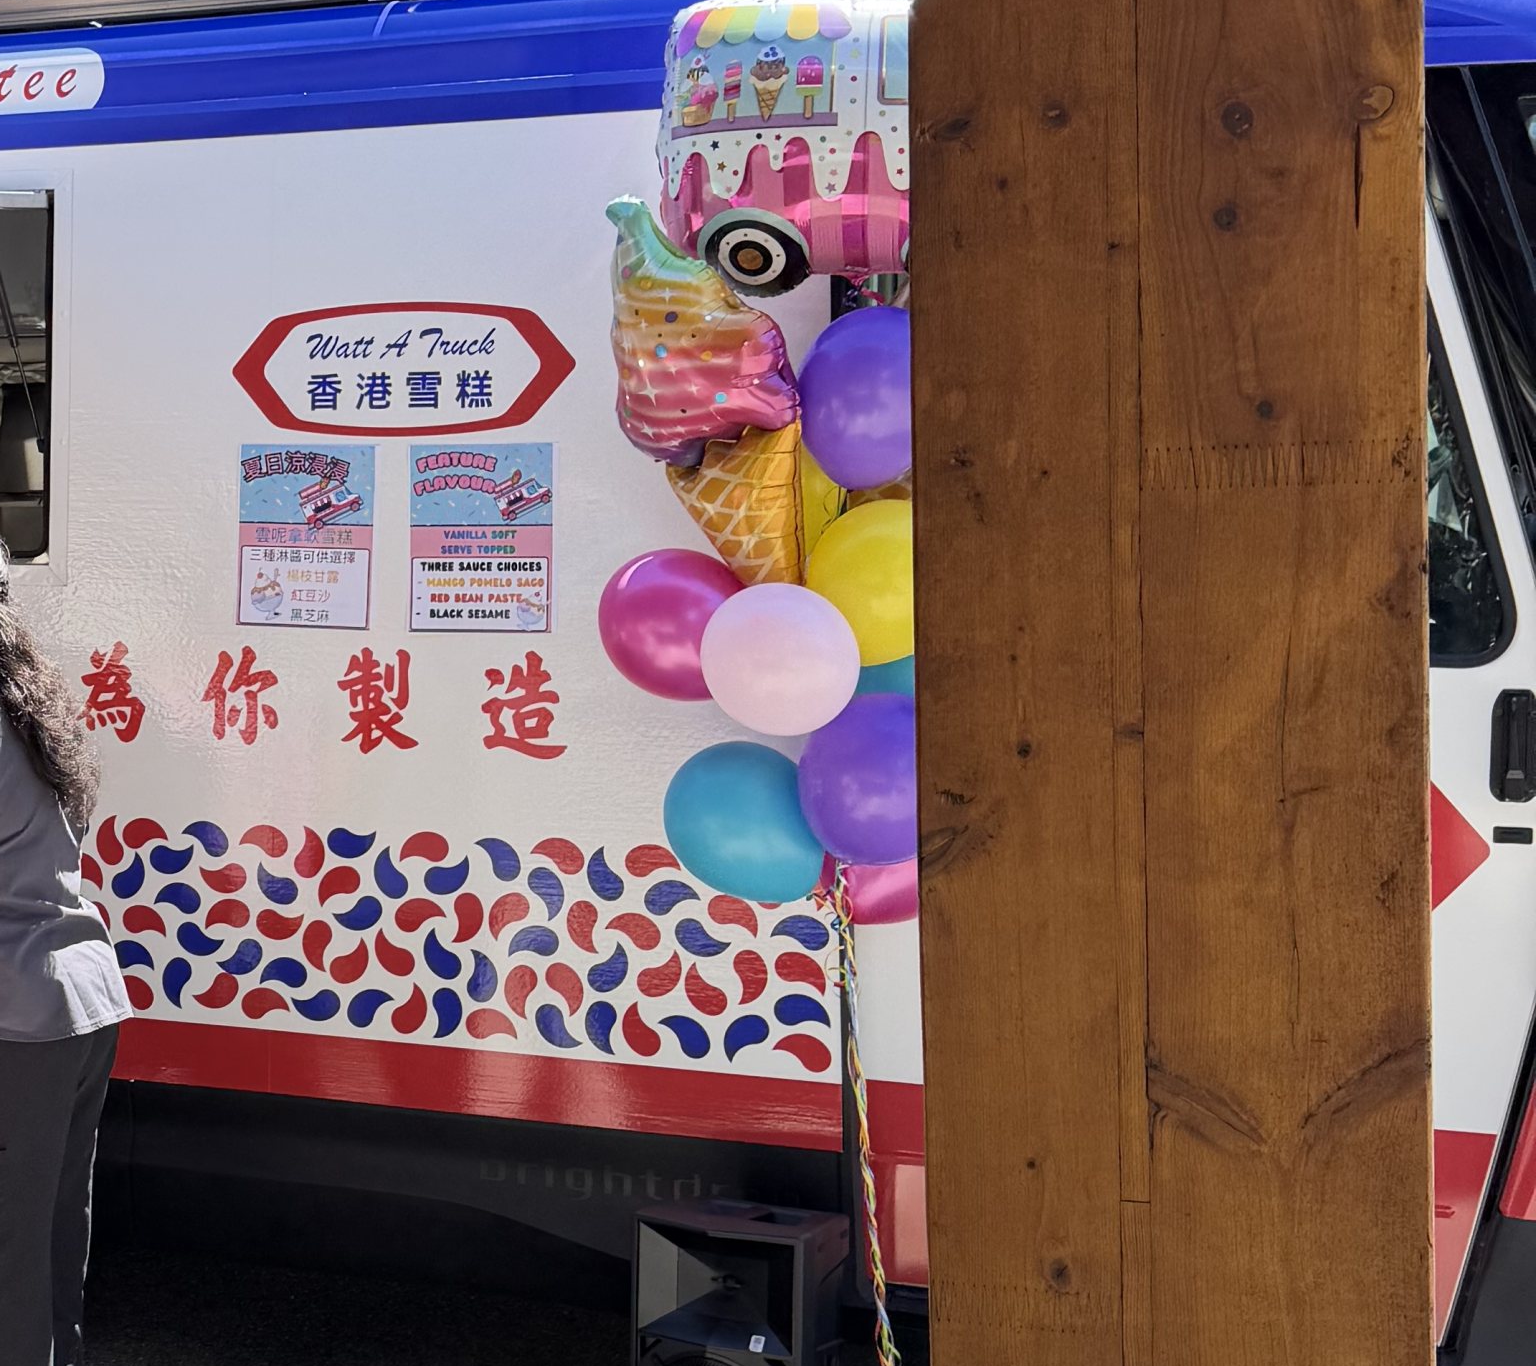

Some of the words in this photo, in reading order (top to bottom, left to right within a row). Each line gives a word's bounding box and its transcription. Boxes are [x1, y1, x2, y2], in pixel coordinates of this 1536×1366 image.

[306, 333, 375, 360] Watt
[379, 328, 412, 359] A
[419, 327, 497, 356] Truck
[306, 369, 494, 411] 香港雪糕
[415, 451, 498, 474] FEATURE
[413, 474, 496, 496] FLAVOUR
[443, 530, 487, 540] VANILLA
[491, 530, 517, 540] SOFT
[440, 545, 473, 554] SERVE
[477, 545, 516, 554] TOPPED
[420, 562, 454, 572] THREE
[458, 562, 493, 572] SAUCE
[497, 562, 542, 572] CHOICES
[426, 578, 465, 587] MANGO
[469, 578, 512, 587] POMELO
[516, 578, 545, 587] SAGO
[430, 594, 450, 603] RED
[454, 594, 483, 603] BEAN
[488, 594, 523, 603] PASTE
[429, 609, 464, 619] BLACK
[467, 609, 510, 619] SESAME
